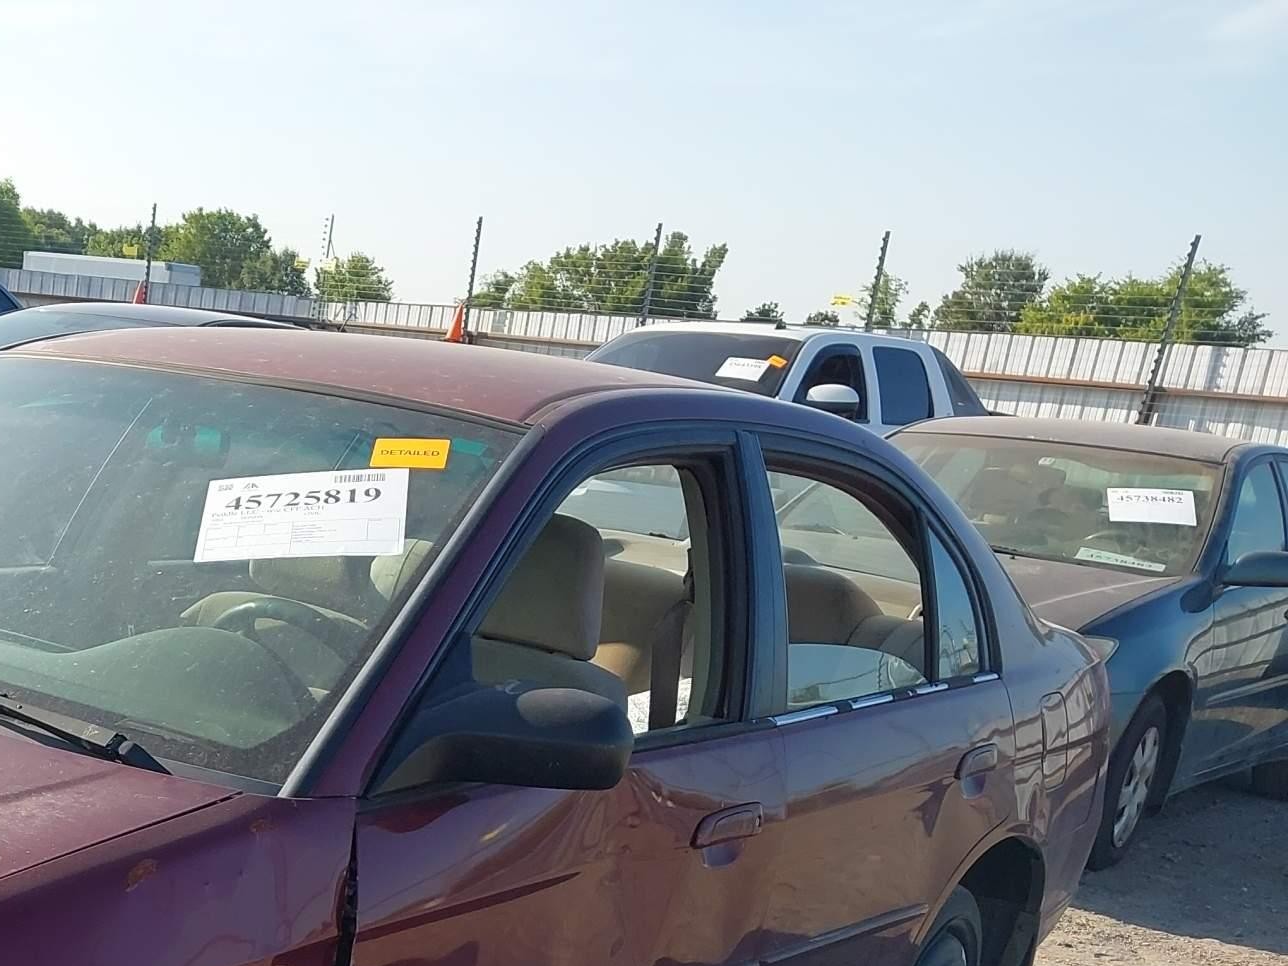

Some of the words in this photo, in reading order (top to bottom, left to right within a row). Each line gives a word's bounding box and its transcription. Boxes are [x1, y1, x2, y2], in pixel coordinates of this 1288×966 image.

[380, 448, 440, 457] DETAILED
[225, 487, 382, 510] 45725819
[1116, 495, 1184, 504] 45738482
